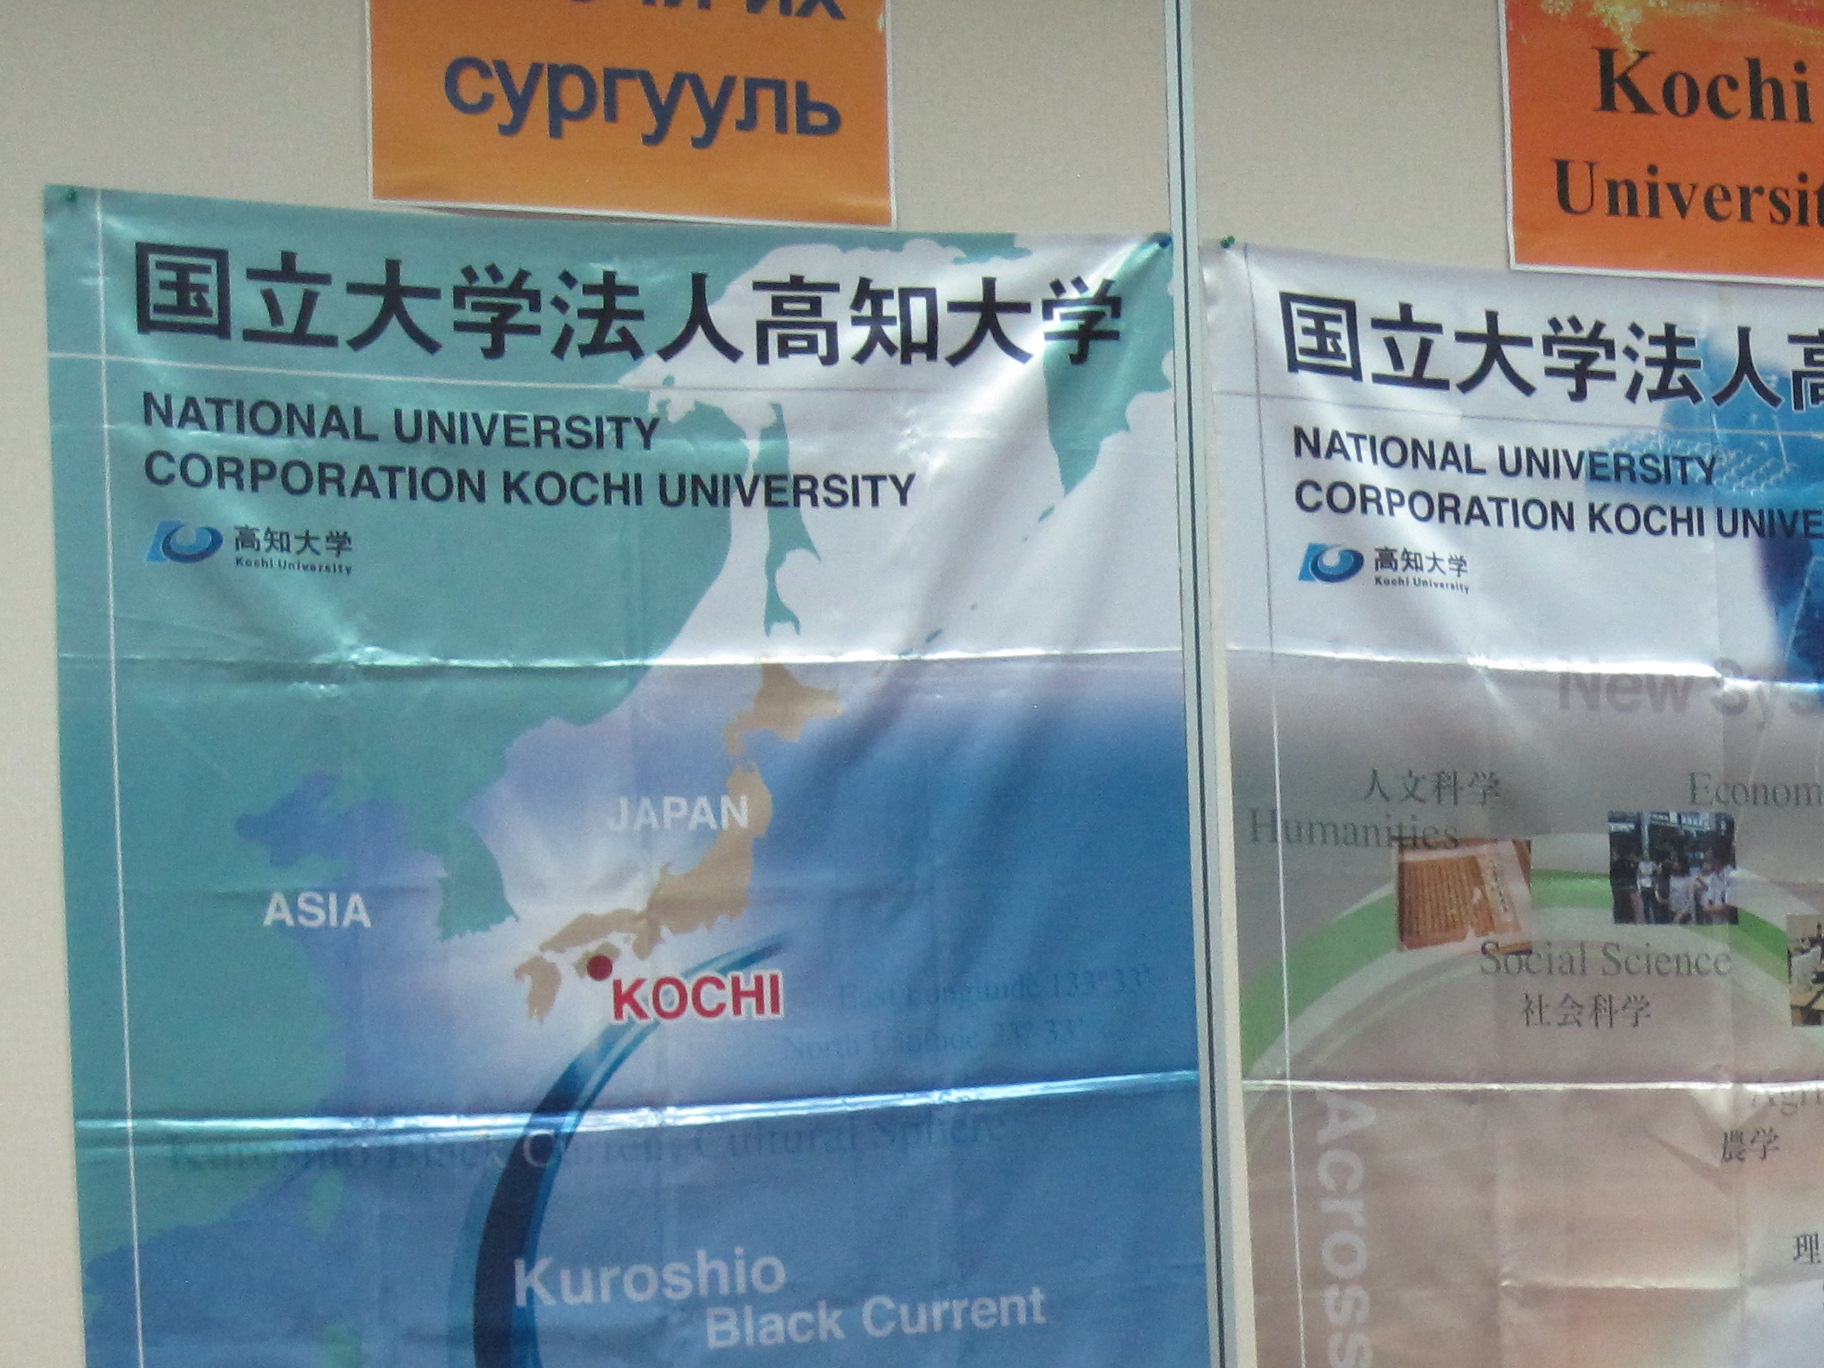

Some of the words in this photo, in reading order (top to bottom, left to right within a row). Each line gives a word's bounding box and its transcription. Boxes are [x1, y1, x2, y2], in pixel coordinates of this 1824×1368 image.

[444, 55, 841, 149] сургууль
[1592, 46, 1814, 123] Kochi
[136, 242, 1124, 366] 国立大学法人高知大学
[143, 393, 379, 441] NATIONAL
[394, 408, 661, 450] UNIVERSITY
[1293, 426, 1486, 476] NATIONAL
[1497, 445, 1717, 485] UNIVERSITY
[145, 450, 486, 503] CORPORATION
[503, 471, 643, 507] KOCHI
[659, 474, 916, 507] UNIVERSITY
[1295, 480, 1575, 532] CORPORATION
[1589, 501, 1706, 538] KOCHI
[235, 524, 353, 557] 高知大学
[1374, 546, 1468, 577] 高知大学
[235, 556, 273, 569] Kochi
[277, 559, 352, 576] University
[1375, 575, 1409, 586] Kochi
[1413, 577, 1469, 594] University
[1557, 672, 1694, 715] New
[1363, 768, 1501, 806] 人文科学
[608, 794, 750, 832] JAPAN
[1248, 807, 1460, 852] Humanities
[263, 891, 371, 928] ASIA
[1479, 940, 1585, 976] Social
[1601, 941, 1733, 978] Science
[611, 974, 783, 1021] KOCHI
[1520, 992, 1652, 1030] 社会科学
[514, 1246, 786, 1309] Kuroshio
[704, 1303, 846, 1350] Black
[861, 1285, 1047, 1338] Current
